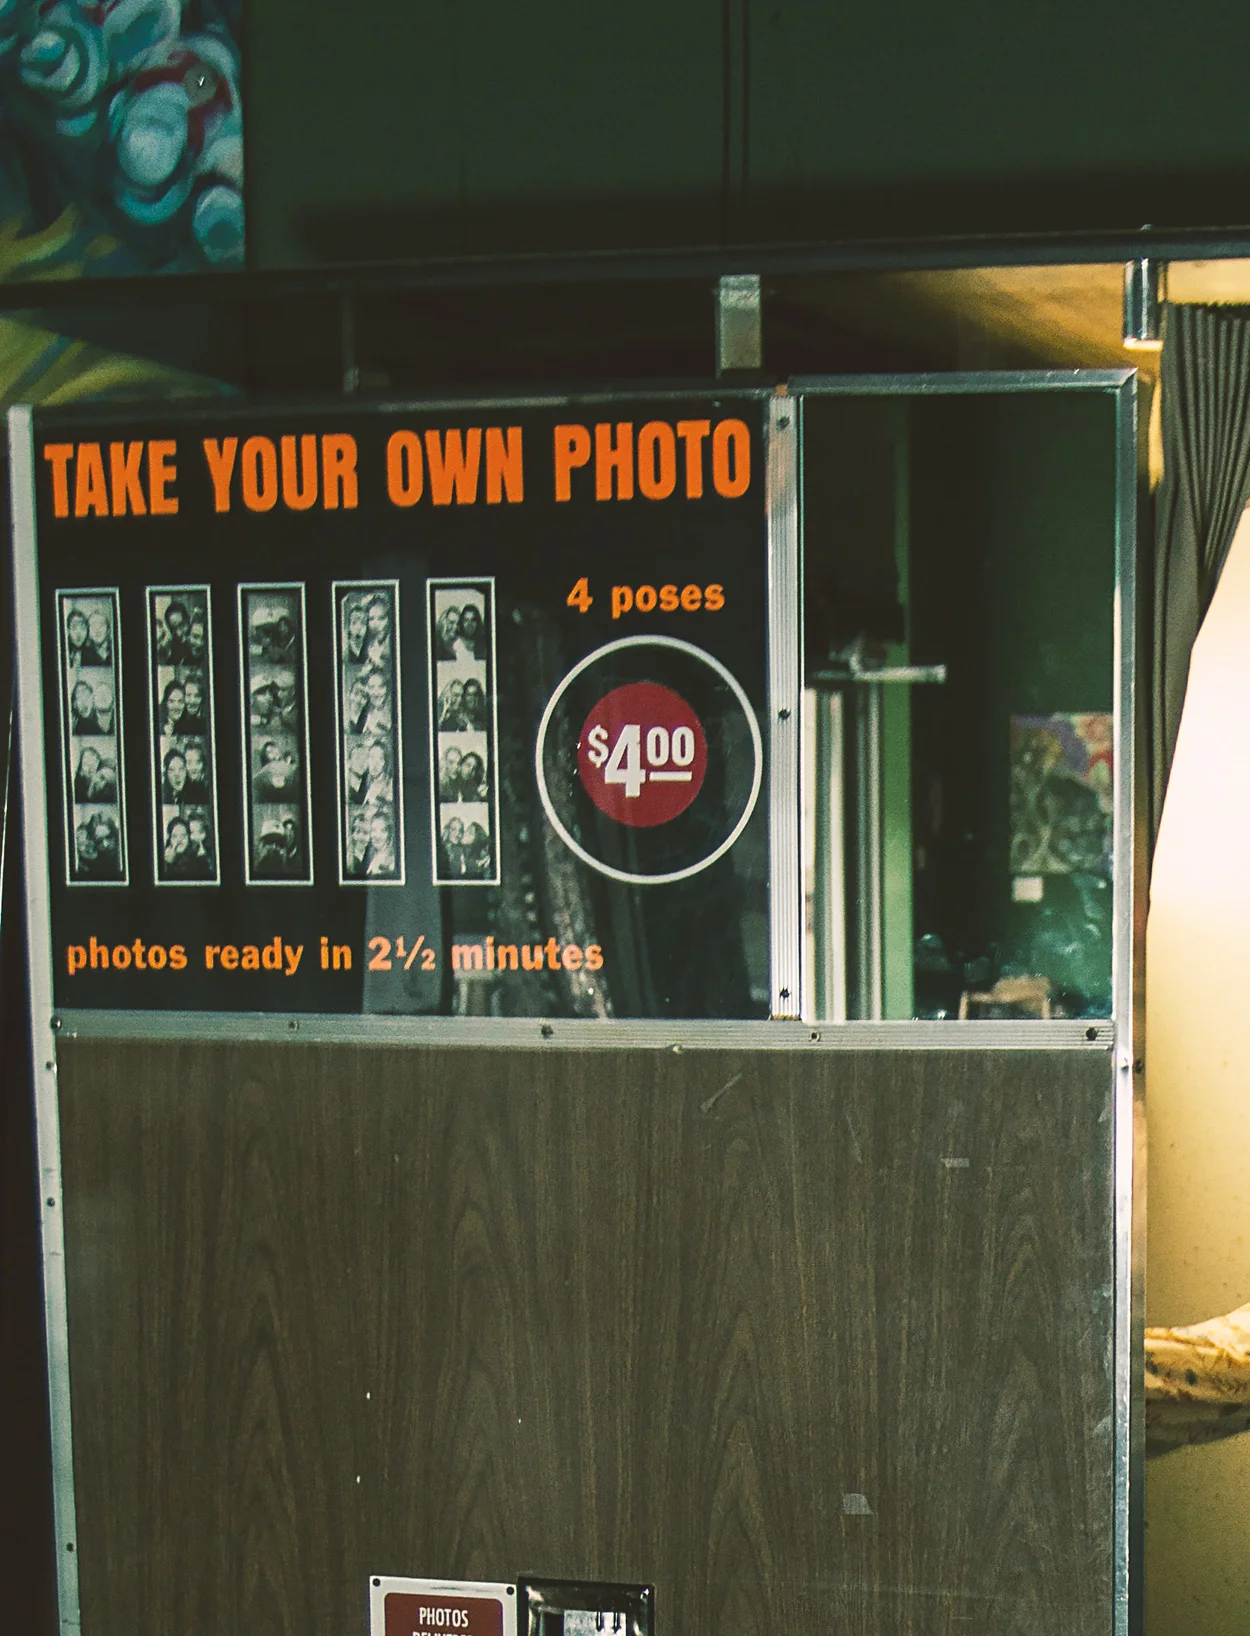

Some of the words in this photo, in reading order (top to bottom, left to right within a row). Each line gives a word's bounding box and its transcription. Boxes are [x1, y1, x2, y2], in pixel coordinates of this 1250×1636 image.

[43, 439, 179, 518] TAKE
[203, 433, 359, 513] YOUR
[386, 426, 524, 507] OWN
[553, 418, 751, 502] PHOTO
[566, 577, 593, 613] 4
[611, 583, 726, 620] poses
[67, 936, 188, 976] photos
[204, 935, 304, 977] ready
[319, 935, 353, 971] in
[451, 935, 605, 971] minutes
[418, 1607, 469, 1629] PHOTOS
